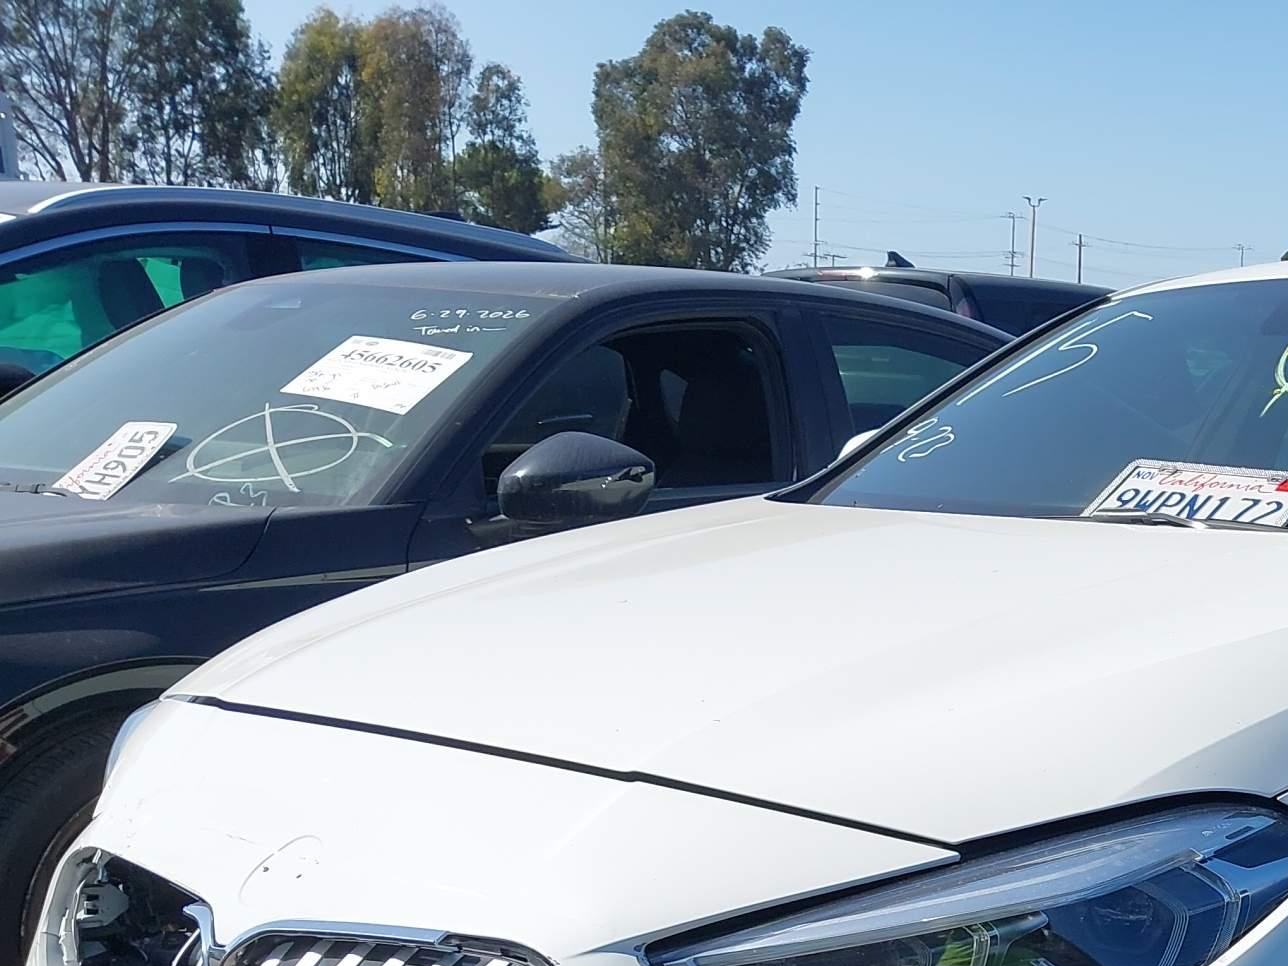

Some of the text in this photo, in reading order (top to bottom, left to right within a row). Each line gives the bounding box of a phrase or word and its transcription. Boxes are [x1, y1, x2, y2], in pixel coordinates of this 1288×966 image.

[340, 349, 442, 374] 45662605
[1133, 470, 1159, 480] NOV
[1158, 469, 1273, 494] California
[1116, 488, 1284, 523] 9WPN172
